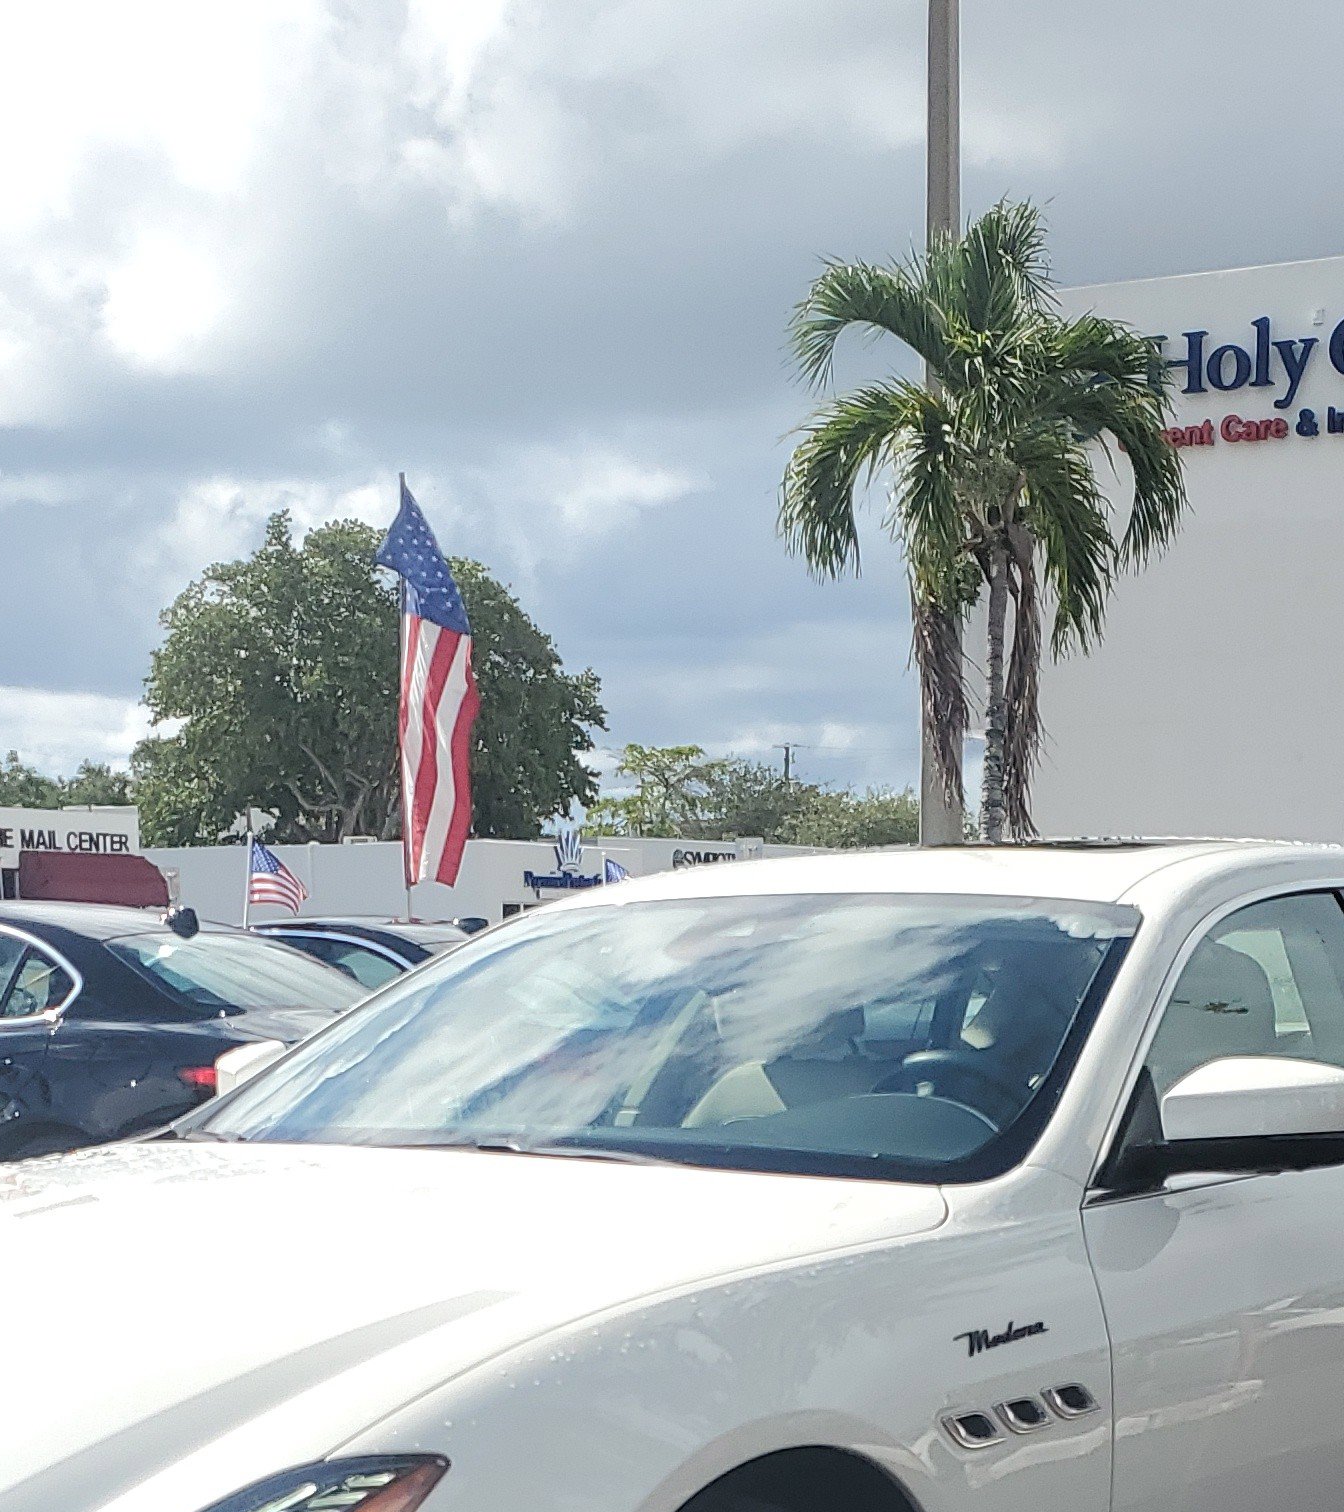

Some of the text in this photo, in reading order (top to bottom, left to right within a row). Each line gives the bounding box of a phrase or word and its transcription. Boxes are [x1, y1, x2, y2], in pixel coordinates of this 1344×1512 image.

[1143, 316, 1320, 409] Holy
[1220, 414, 1289, 442] Care
[1295, 408, 1320, 436] &
[20, 829, 62, 850] MAIL
[66, 831, 130, 852] CENTER
[953, 1321, 1050, 1357] Modena
